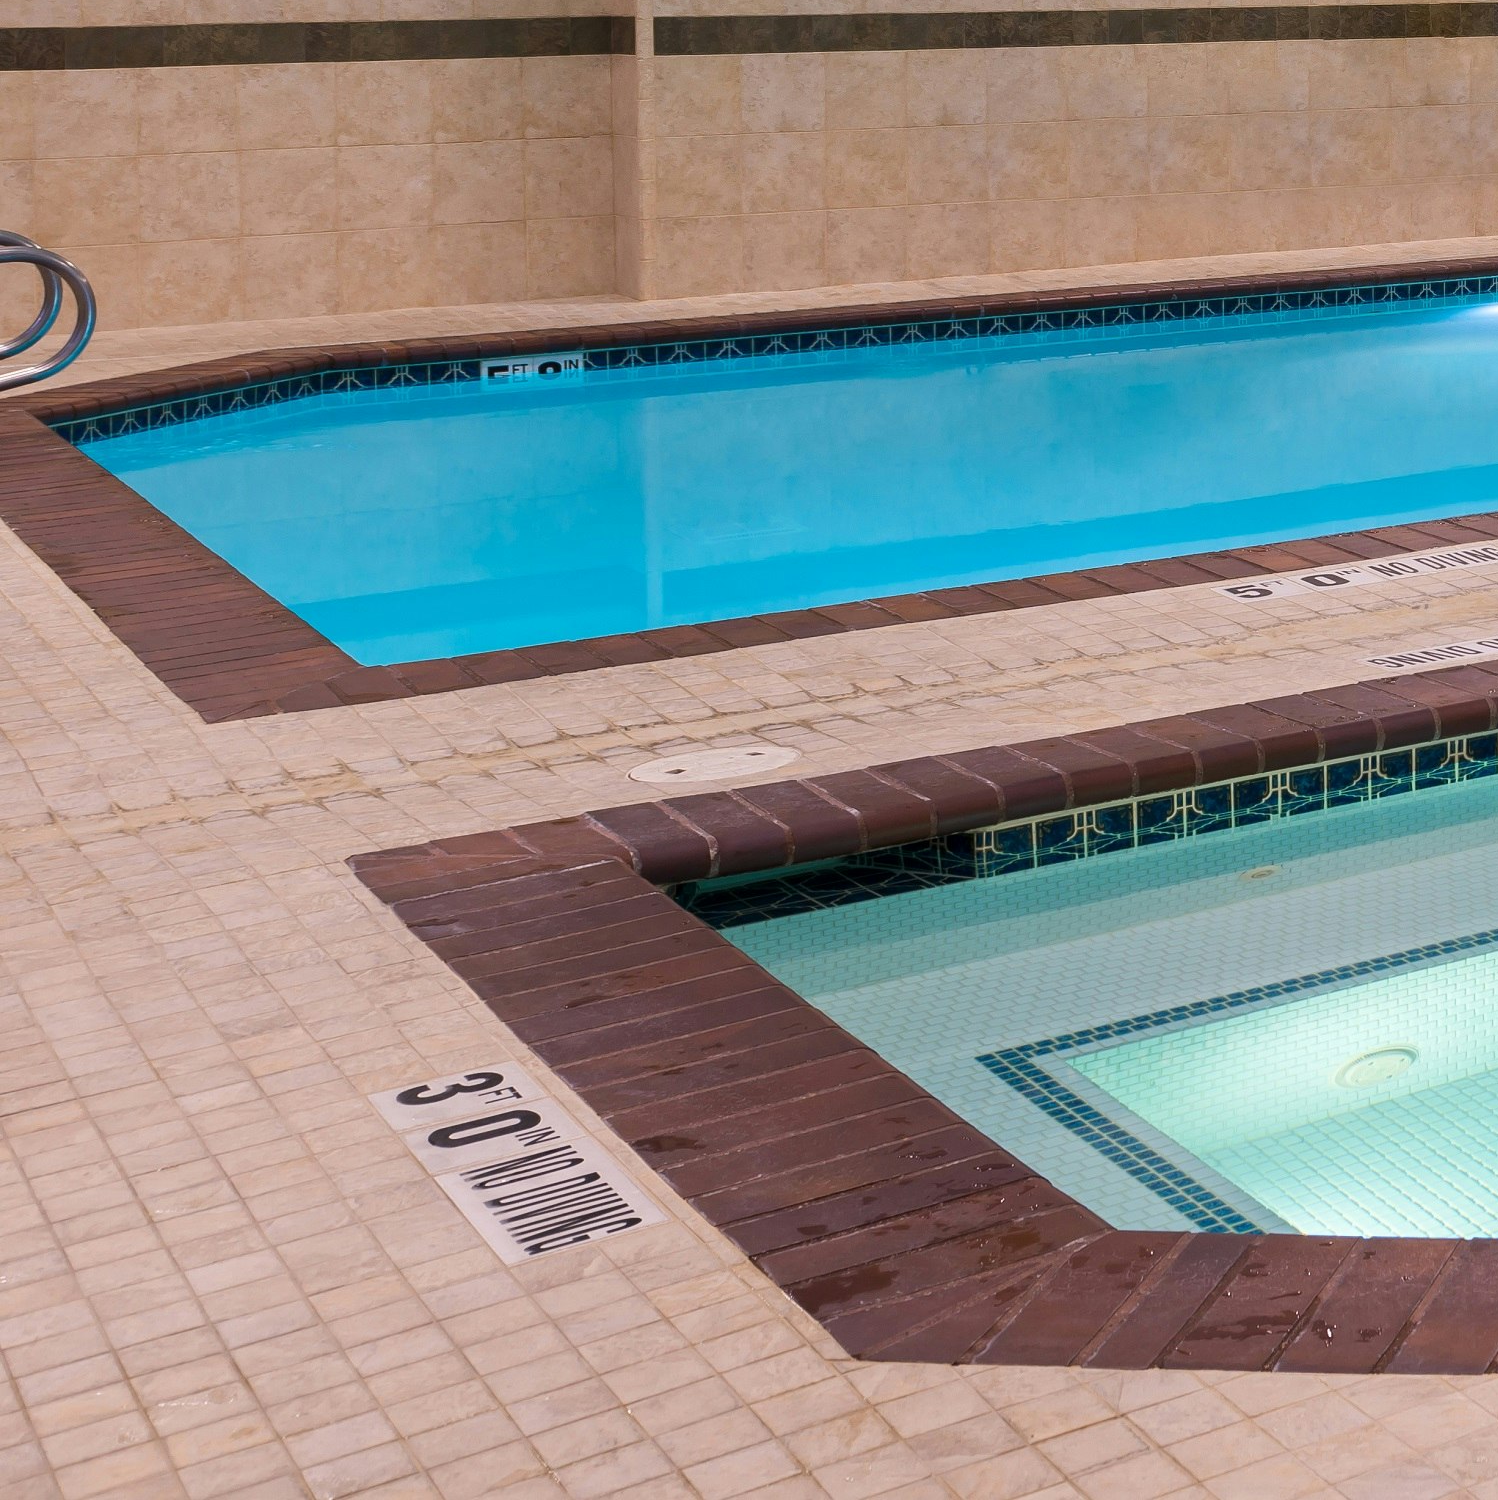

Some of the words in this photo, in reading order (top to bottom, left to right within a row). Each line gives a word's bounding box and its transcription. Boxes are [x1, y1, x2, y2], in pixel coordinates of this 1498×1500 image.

[1224, 585, 1273, 599] 5
[1300, 573, 1350, 587] 0
[1369, 562, 1418, 577] NO
[1368, 645, 1484, 668] DIVING
[396, 1072, 504, 1106] 3
[478, 1086, 523, 1105] FT
[427, 1110, 541, 1148] 0
[515, 1126, 561, 1147] IN
[459, 1145, 585, 1190] NO
[483, 1171, 643, 1256] DIVING
